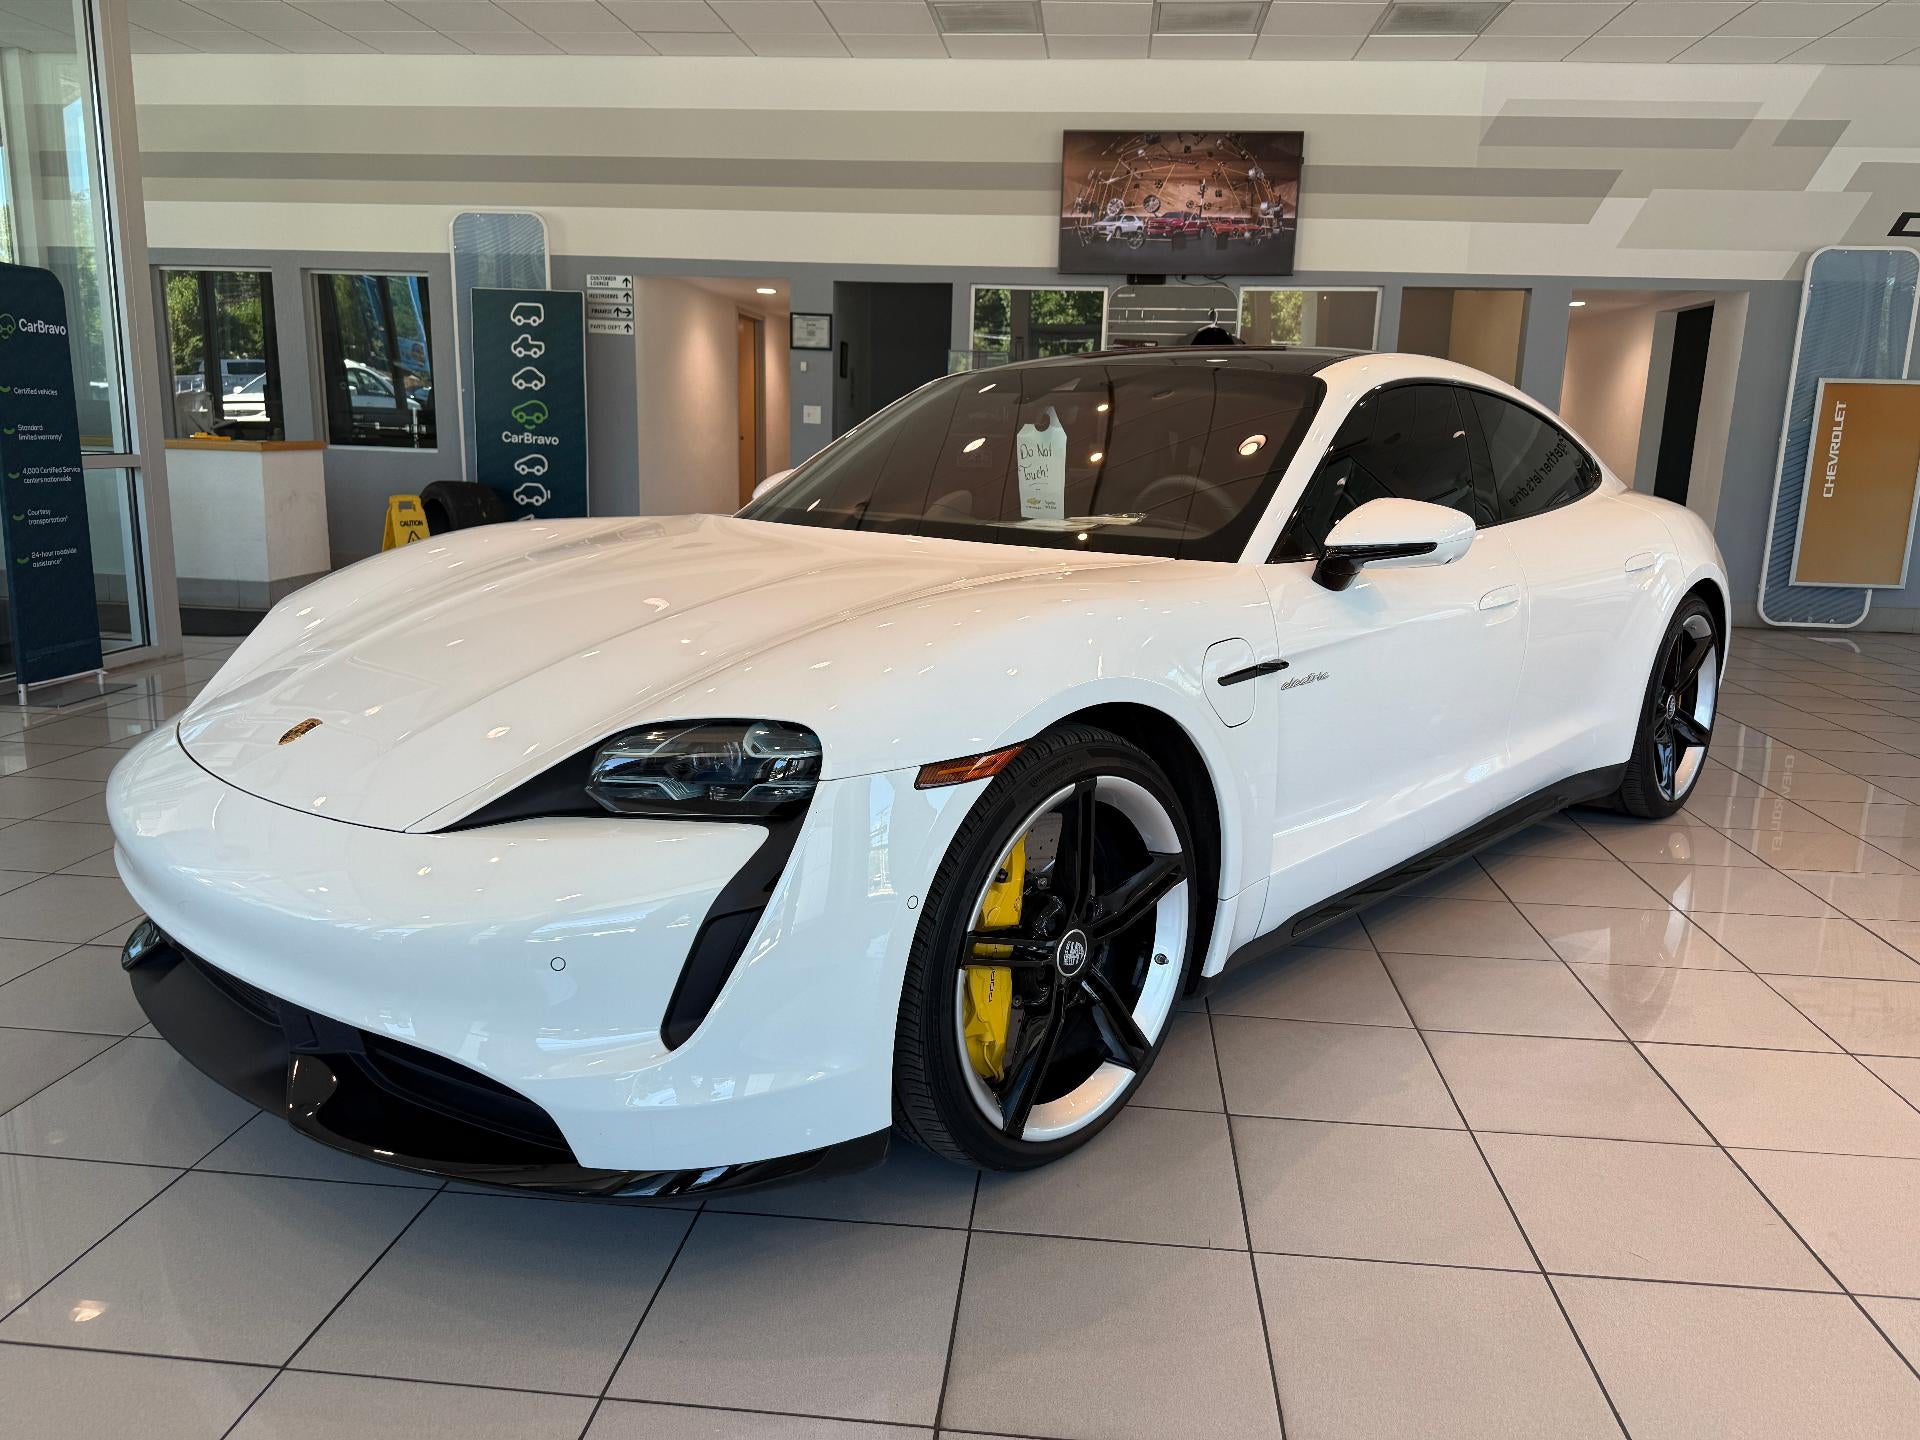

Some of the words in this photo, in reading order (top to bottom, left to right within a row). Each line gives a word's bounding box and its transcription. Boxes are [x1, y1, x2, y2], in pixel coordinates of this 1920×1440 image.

[18, 318, 67, 335] CarBravo
[13, 386, 38, 395] Certified
[38, 388, 58, 396] vehicles
[18, 433, 37, 441] limited
[501, 431, 560, 445] CarBravo
[1020, 443, 1034, 459] Do
[1037, 443, 1052, 457] Not
[1823, 400, 1847, 498] CHEVROLET
[22, 466, 40, 475] 4,000
[23, 476, 43, 484] centers
[44, 474, 72, 483] nationwide
[400, 519, 424, 527] CAUTION
[31, 550, 54, 559] 24-hour
[54, 547, 78, 556] roadside
